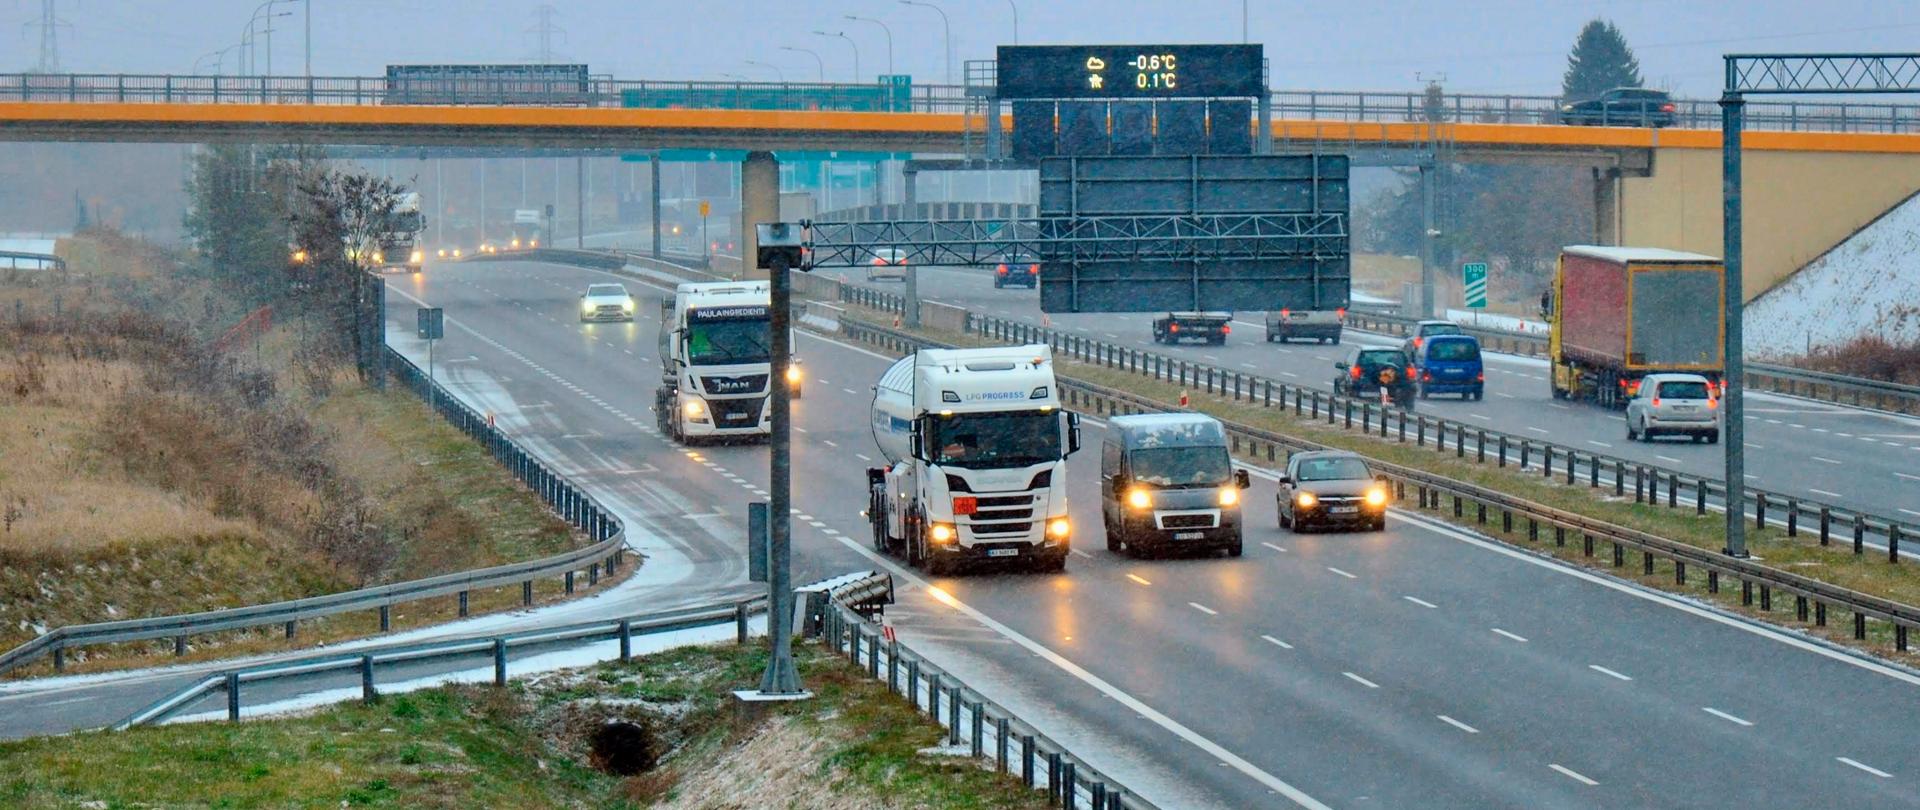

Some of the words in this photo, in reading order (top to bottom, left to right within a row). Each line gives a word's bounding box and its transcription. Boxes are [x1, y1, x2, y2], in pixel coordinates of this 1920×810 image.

[1127, 54, 1176, 70] -0.6°C
[1136, 73, 1176, 88] 0.1°C
[697, 310, 722, 318] PAULA
[721, 381, 750, 390] MAN
